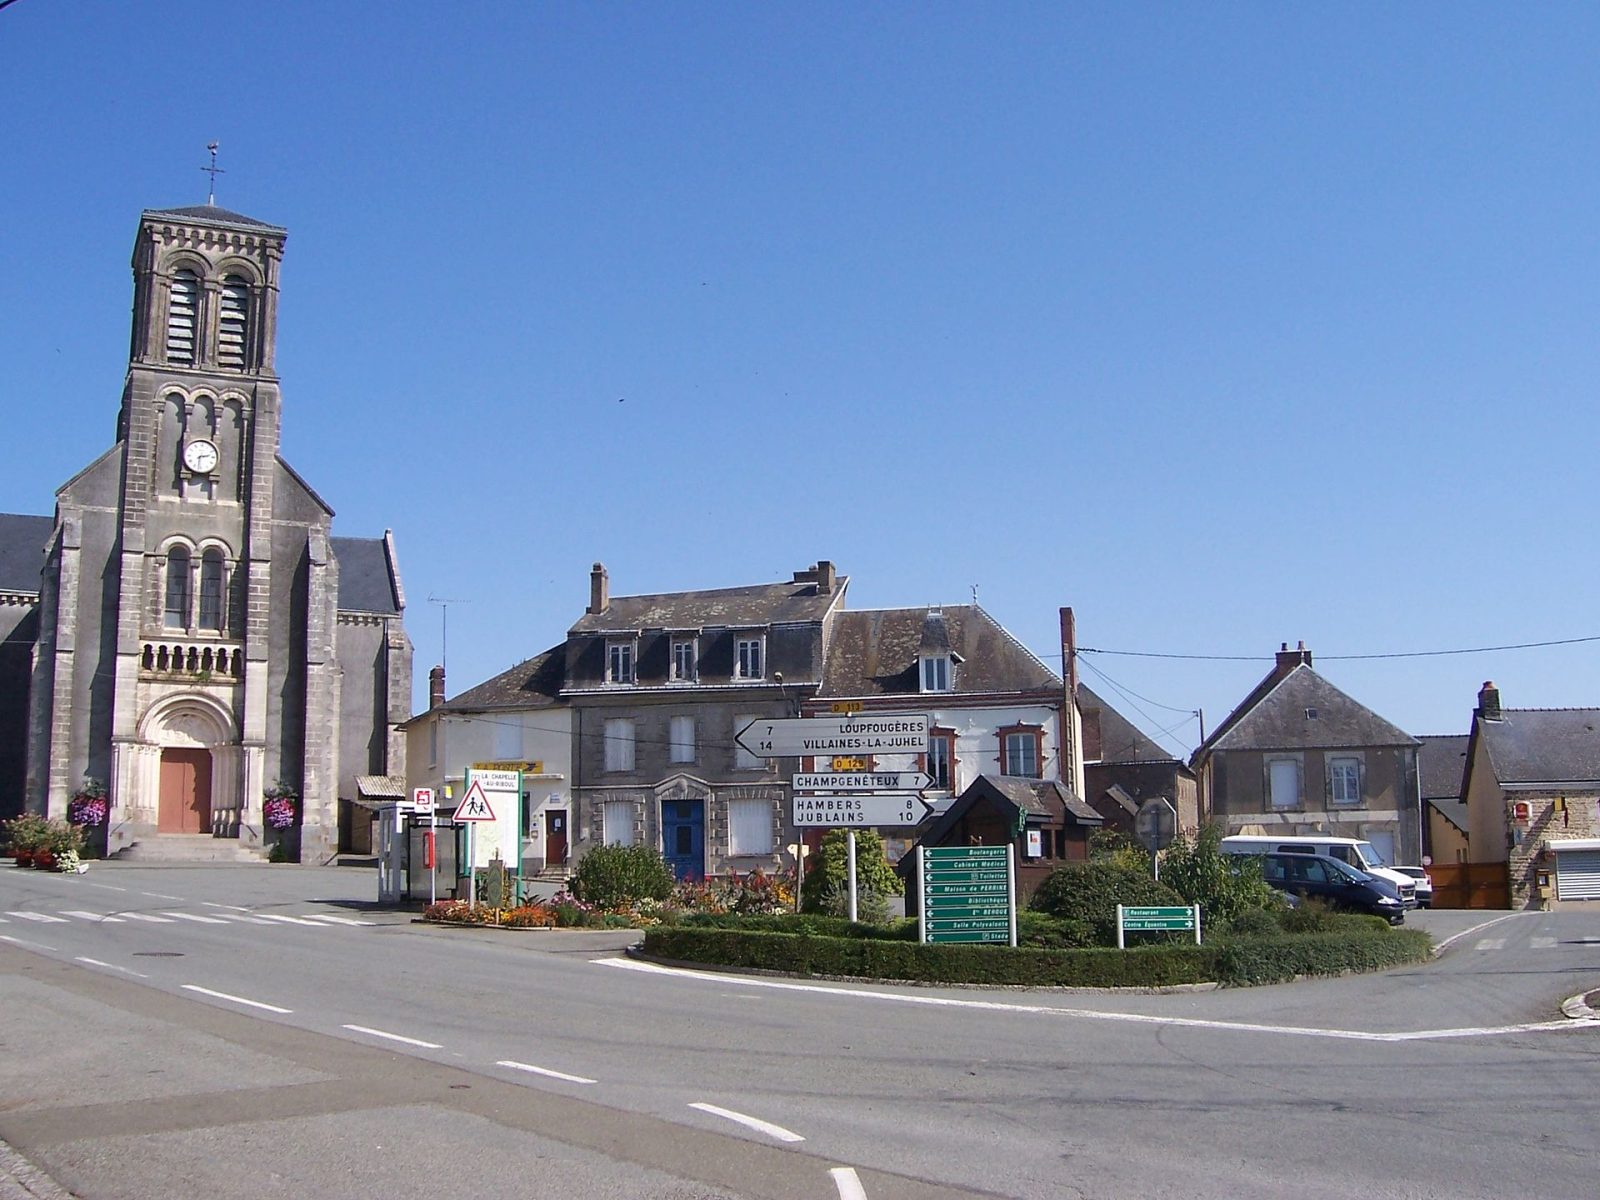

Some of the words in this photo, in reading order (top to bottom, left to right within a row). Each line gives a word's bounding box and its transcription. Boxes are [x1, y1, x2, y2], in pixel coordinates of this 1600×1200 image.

[767, 726, 773, 736] 7
[839, 720, 924, 734] LOUPFOUGÈRES
[760, 741, 773, 751] 14
[803, 737, 924, 749] VILLAINES-LA-JUHEL
[836, 760, 842, 768] D
[848, 759, 864, 767] 129
[797, 774, 899, 787] CHAMPGENÉTEUX
[914, 776, 920, 785] 7
[797, 800, 862, 810] HAMBERS
[906, 800, 913, 809] 8
[797, 812, 864, 822] JUBLAINS
[899, 812, 913, 821] 10
